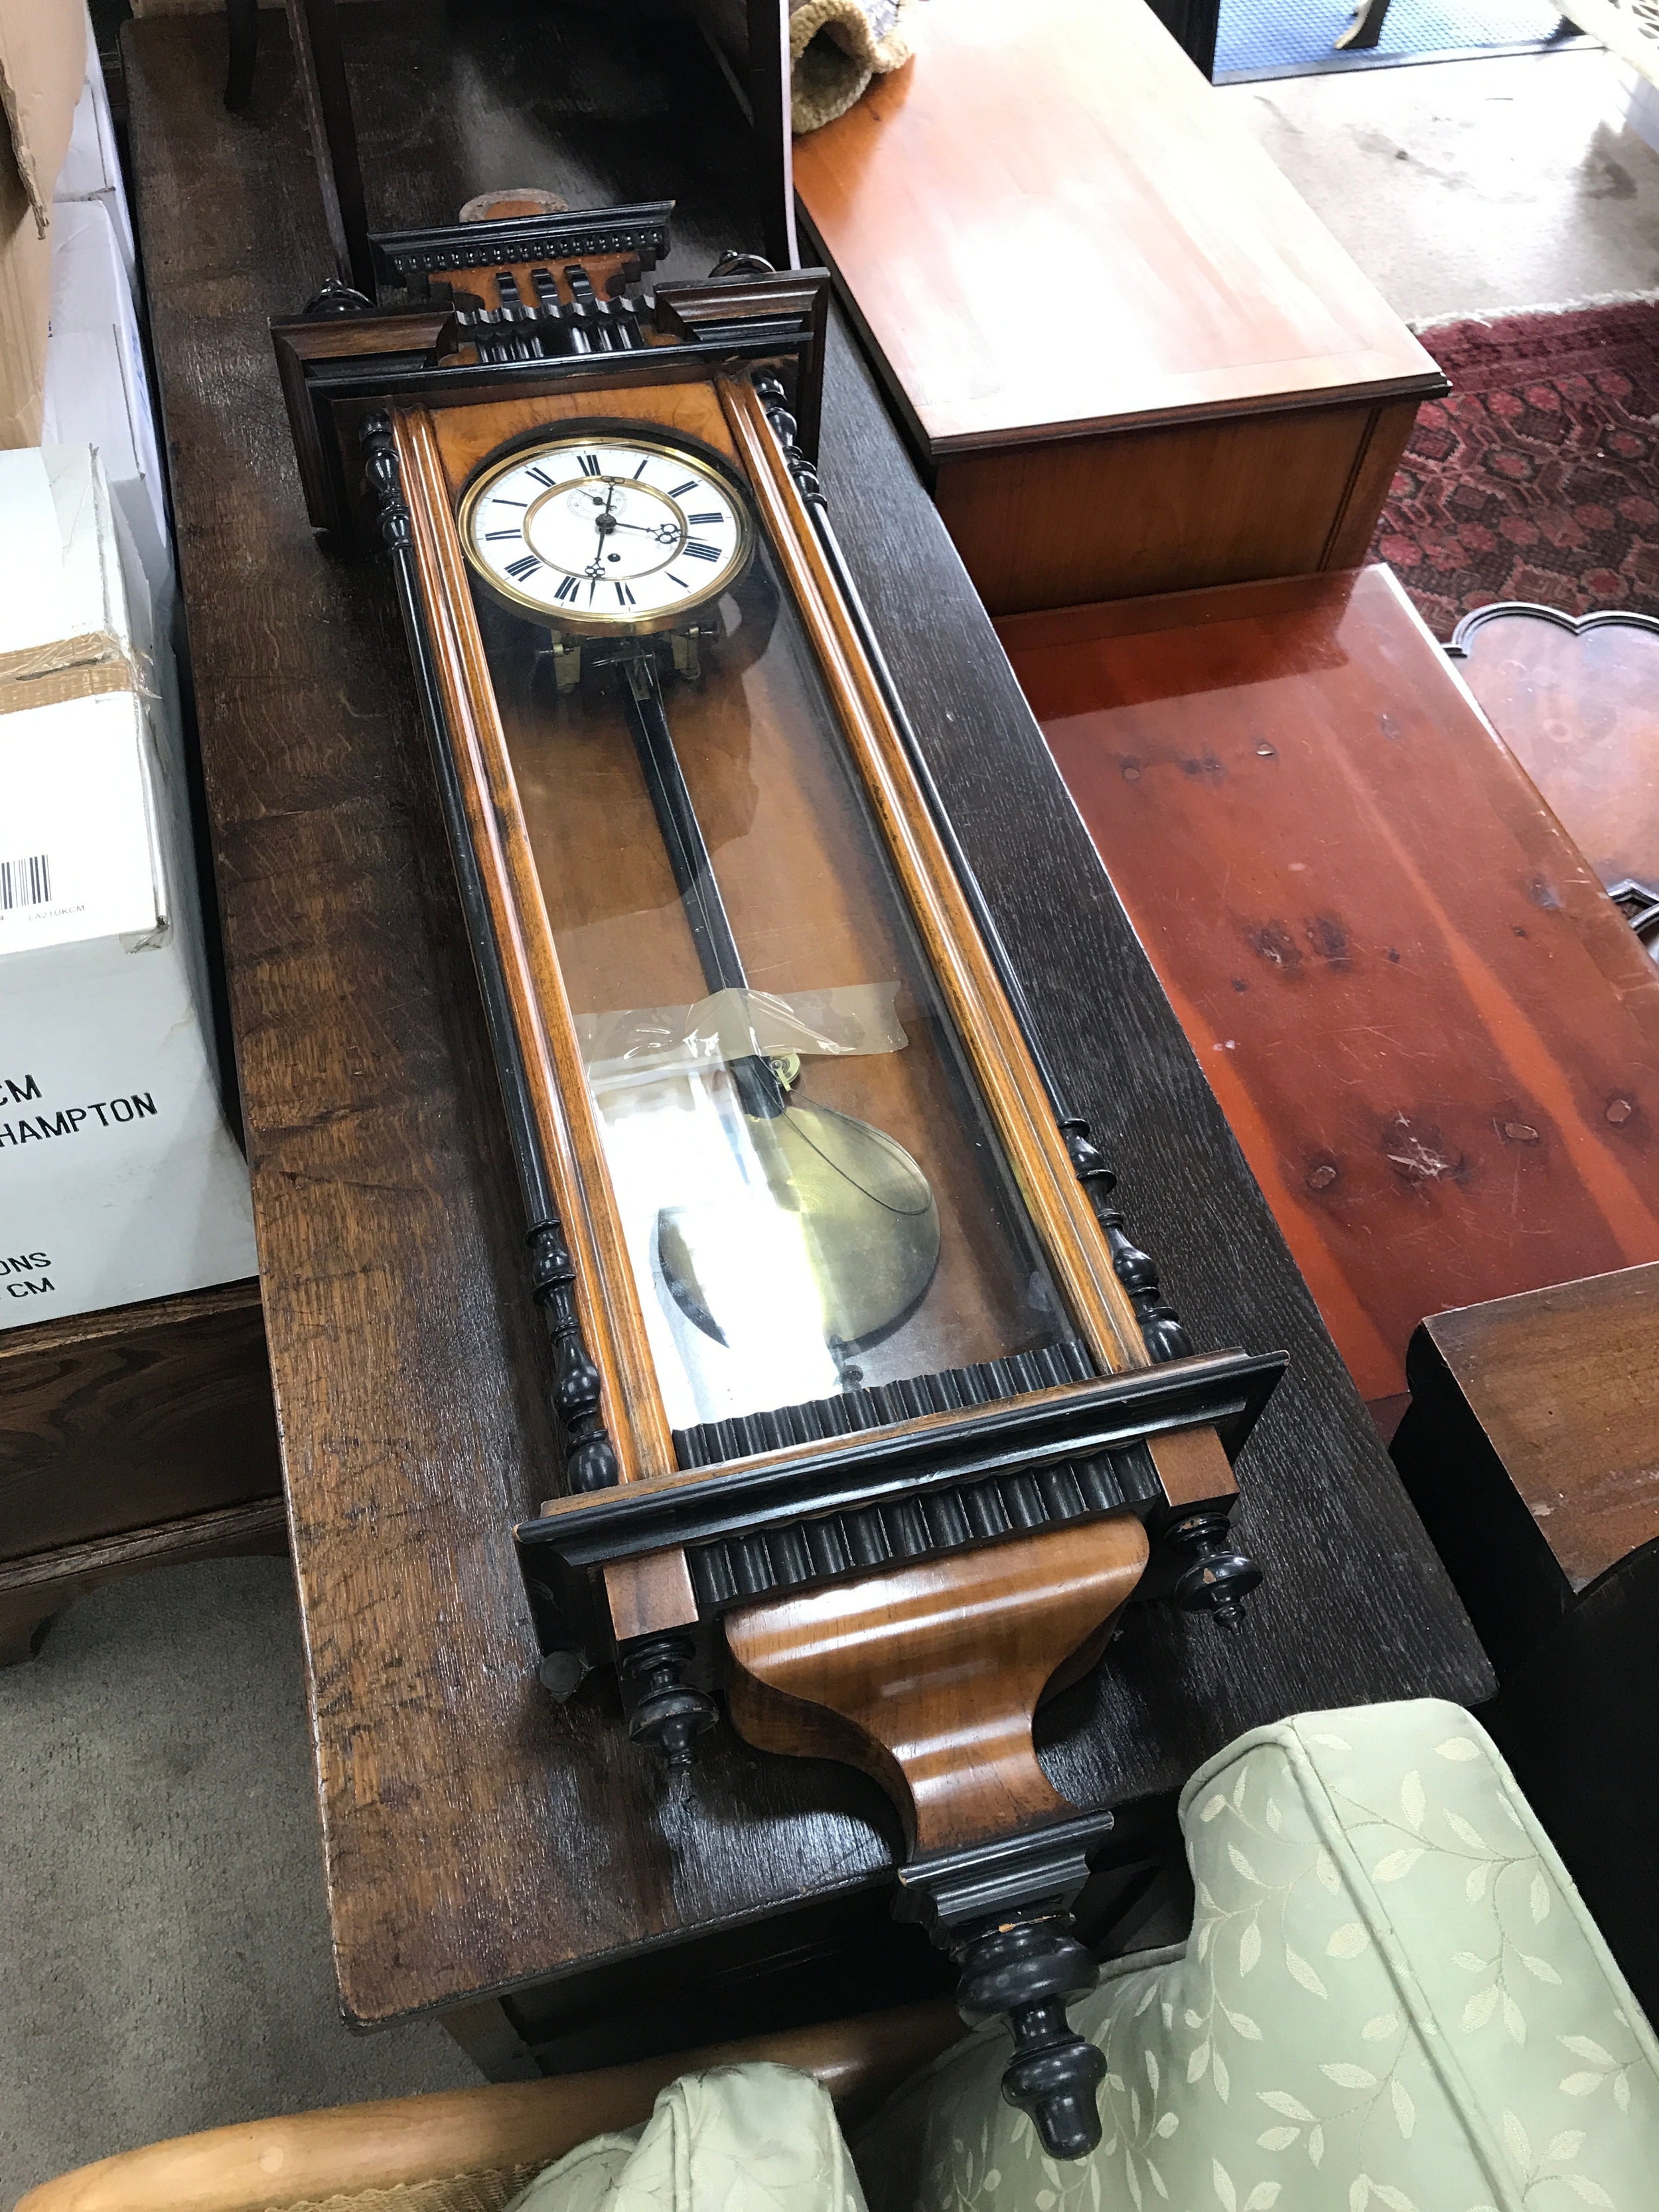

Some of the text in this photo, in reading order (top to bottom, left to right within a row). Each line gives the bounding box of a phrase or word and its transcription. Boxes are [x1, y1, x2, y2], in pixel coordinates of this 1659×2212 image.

[667, 480, 699, 498] II
[687, 512, 724, 525] III
[682, 541, 723, 563] IIII
[0, 1092, 158, 1147] HAMPTON
[6, 1277, 56, 1297] CM
